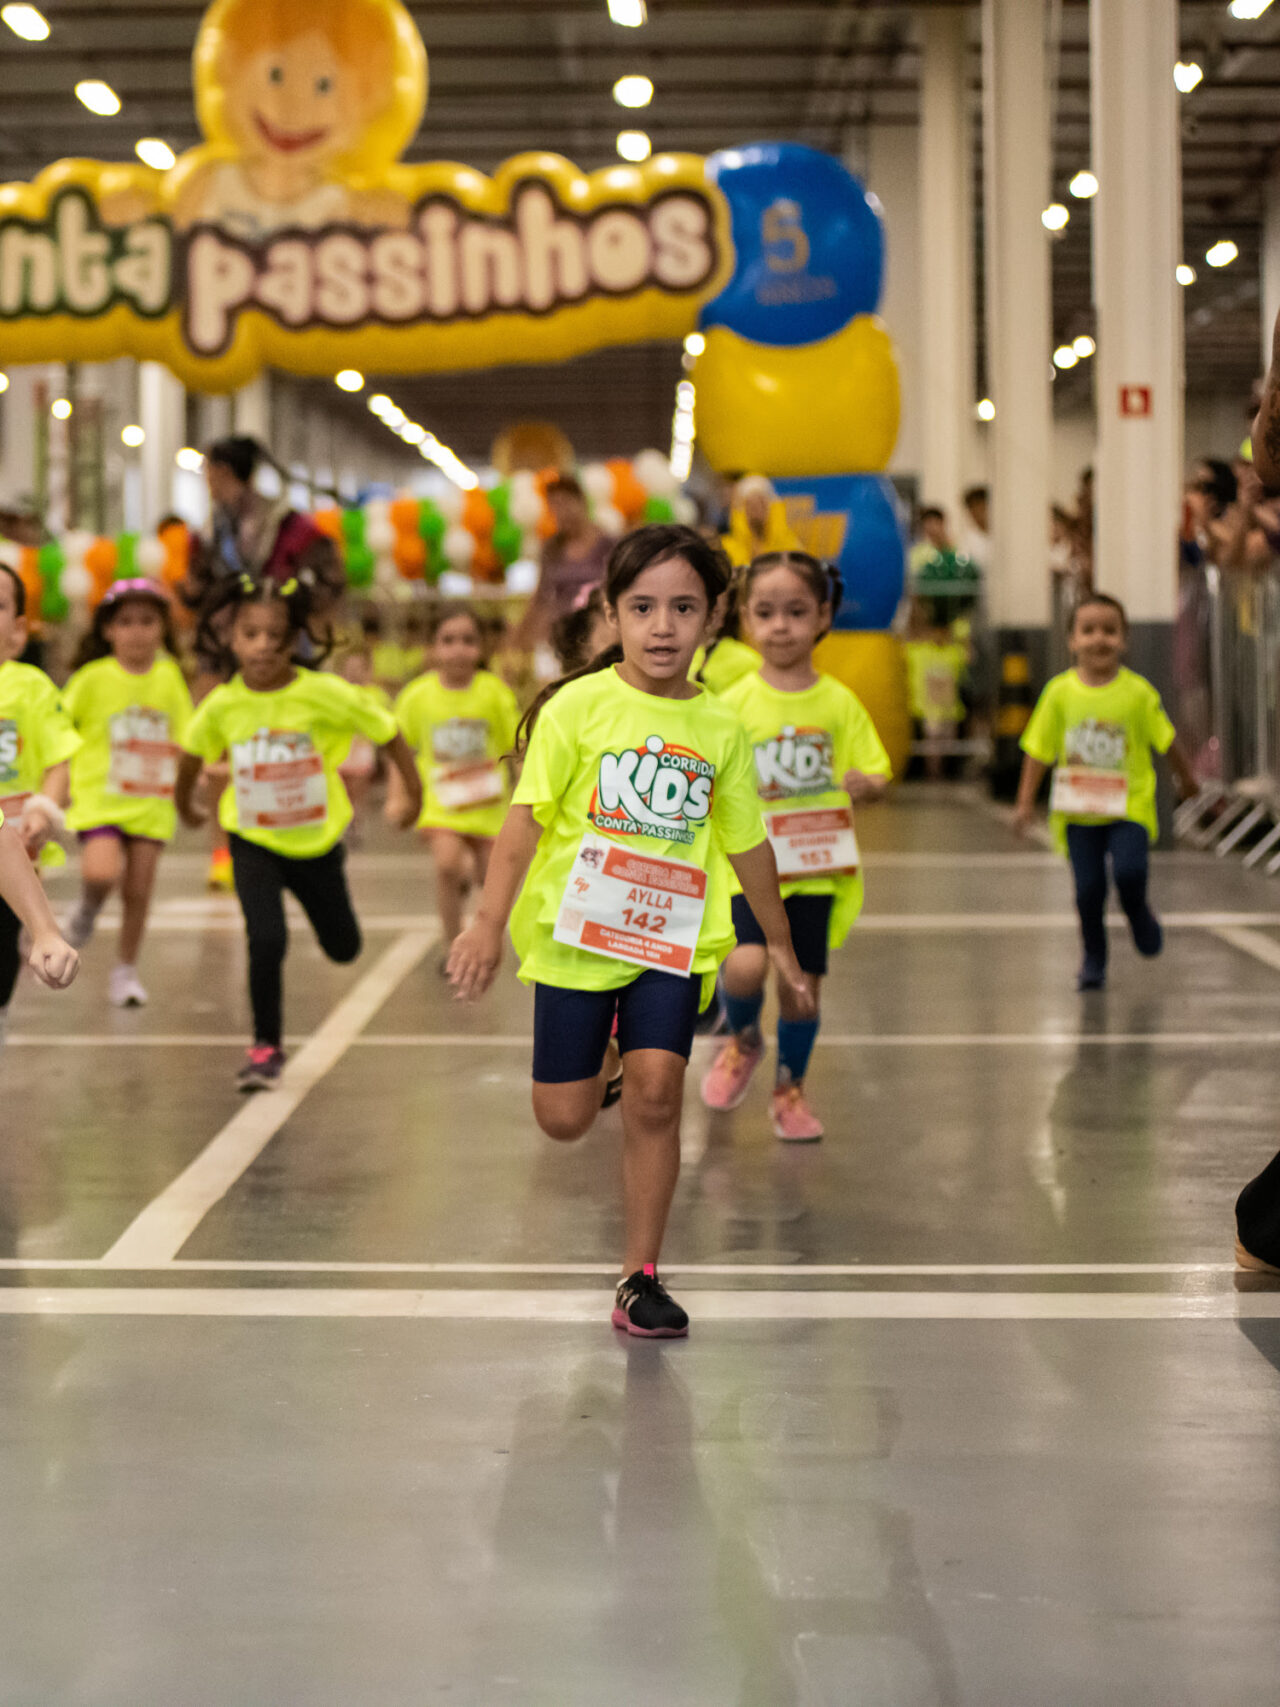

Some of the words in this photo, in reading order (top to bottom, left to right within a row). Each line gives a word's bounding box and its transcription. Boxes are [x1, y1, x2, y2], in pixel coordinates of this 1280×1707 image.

[763, 198, 810, 273] 5
[188, 185, 710, 352] passinhos
[595, 814, 639, 834] CONTA
[626, 887, 673, 911] AYLLA
[622, 908, 667, 934] 142
